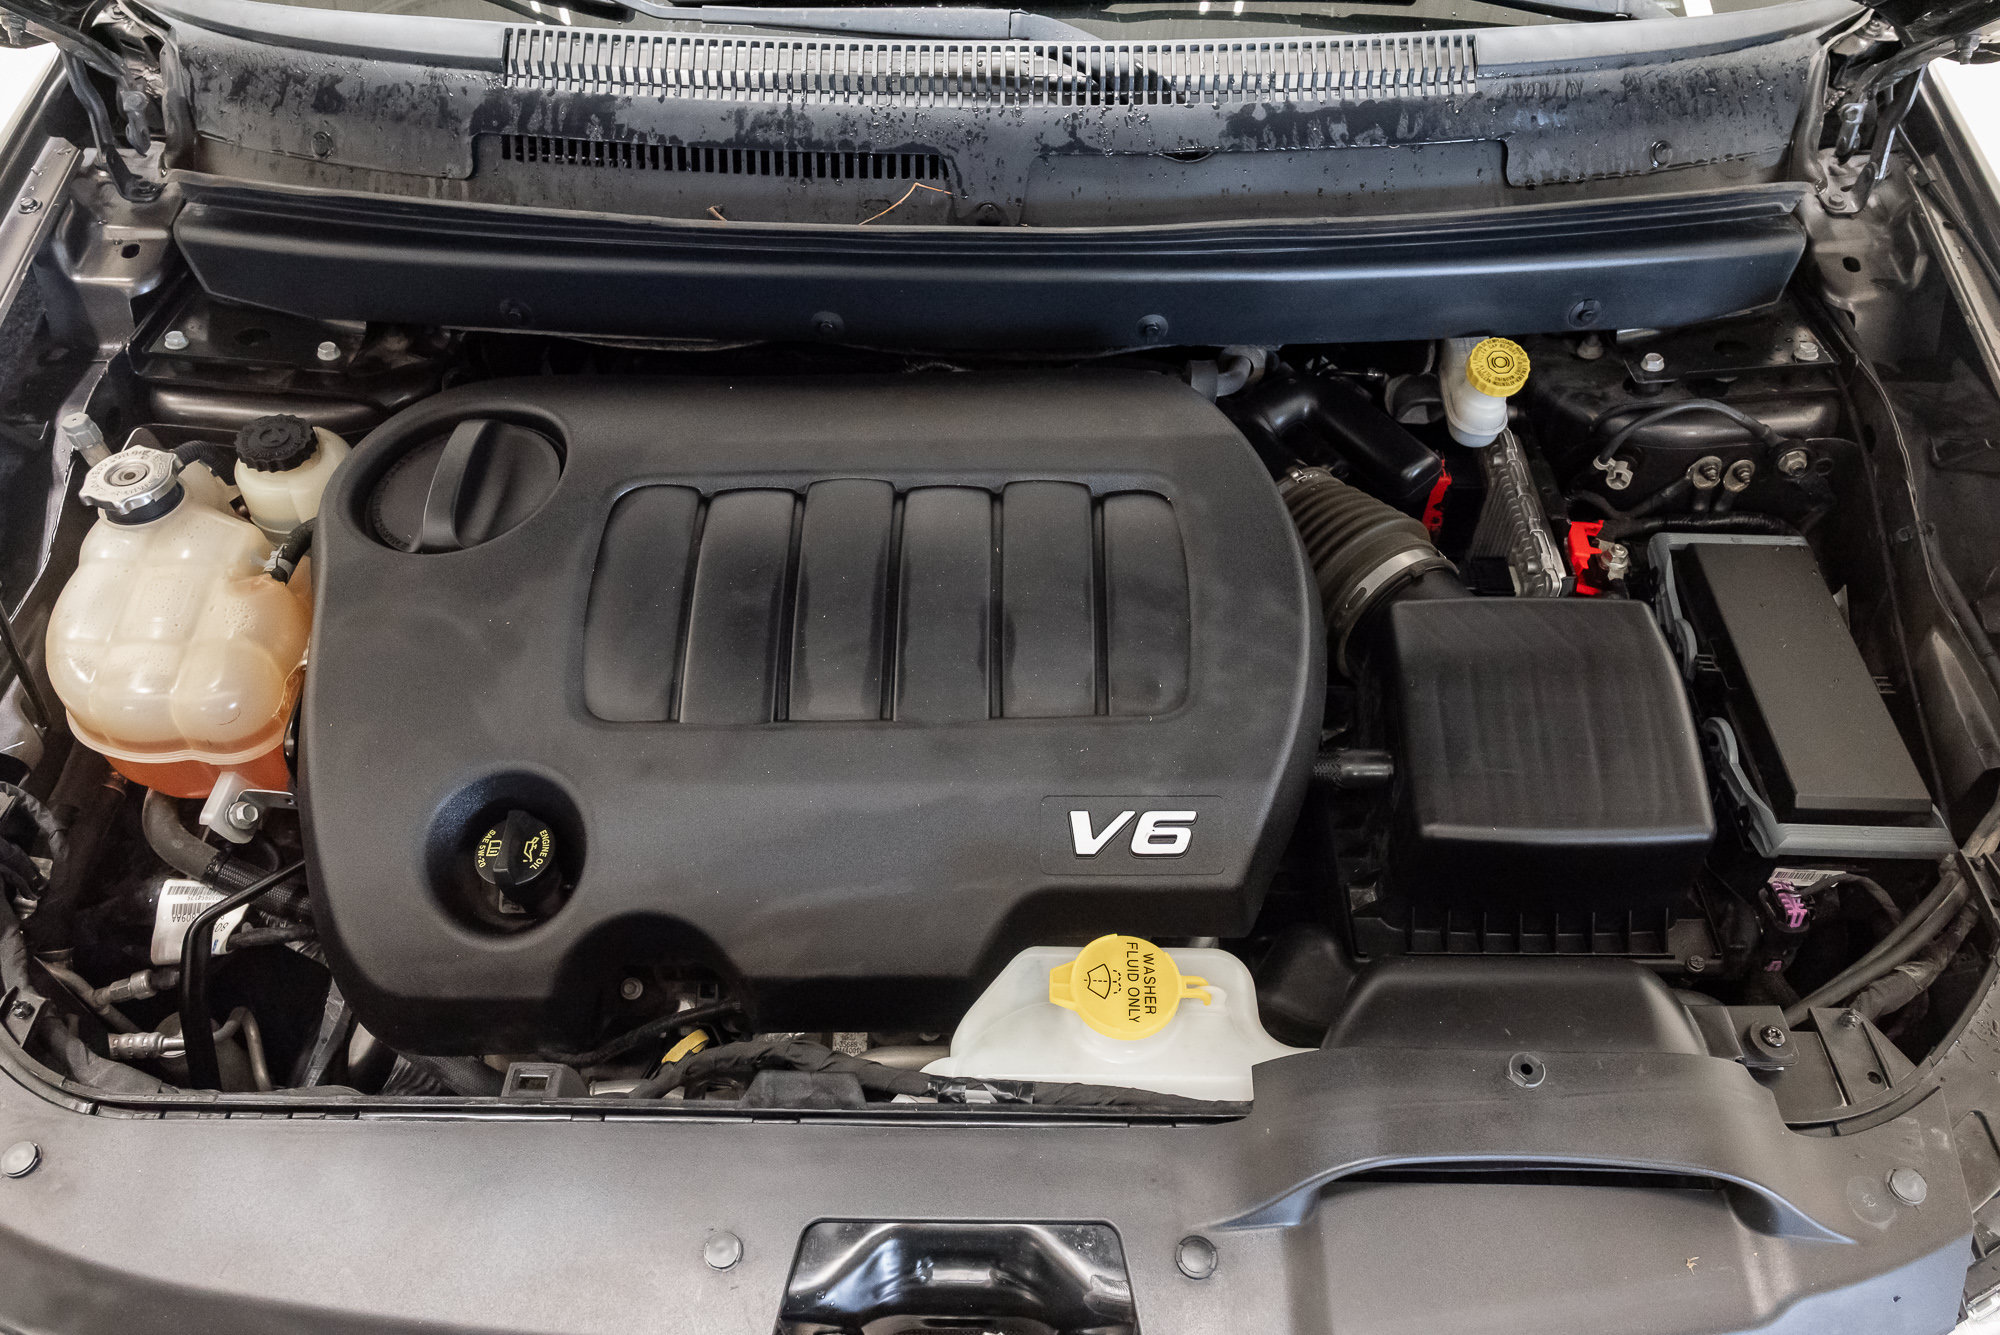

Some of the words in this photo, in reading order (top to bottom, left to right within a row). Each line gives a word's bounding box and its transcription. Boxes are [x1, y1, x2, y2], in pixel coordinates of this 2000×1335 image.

[481, 829, 497, 844] SAE
[539, 829, 550, 858] ENGINE
[1068, 809, 1198, 858] V6
[477, 844, 487, 868] 5W-20
[529, 858, 544, 870] OIL
[1126, 942, 1140, 982] FLUID
[1143, 952, 1157, 1015] WASHER
[1127, 987, 1141, 1023] ONLY
